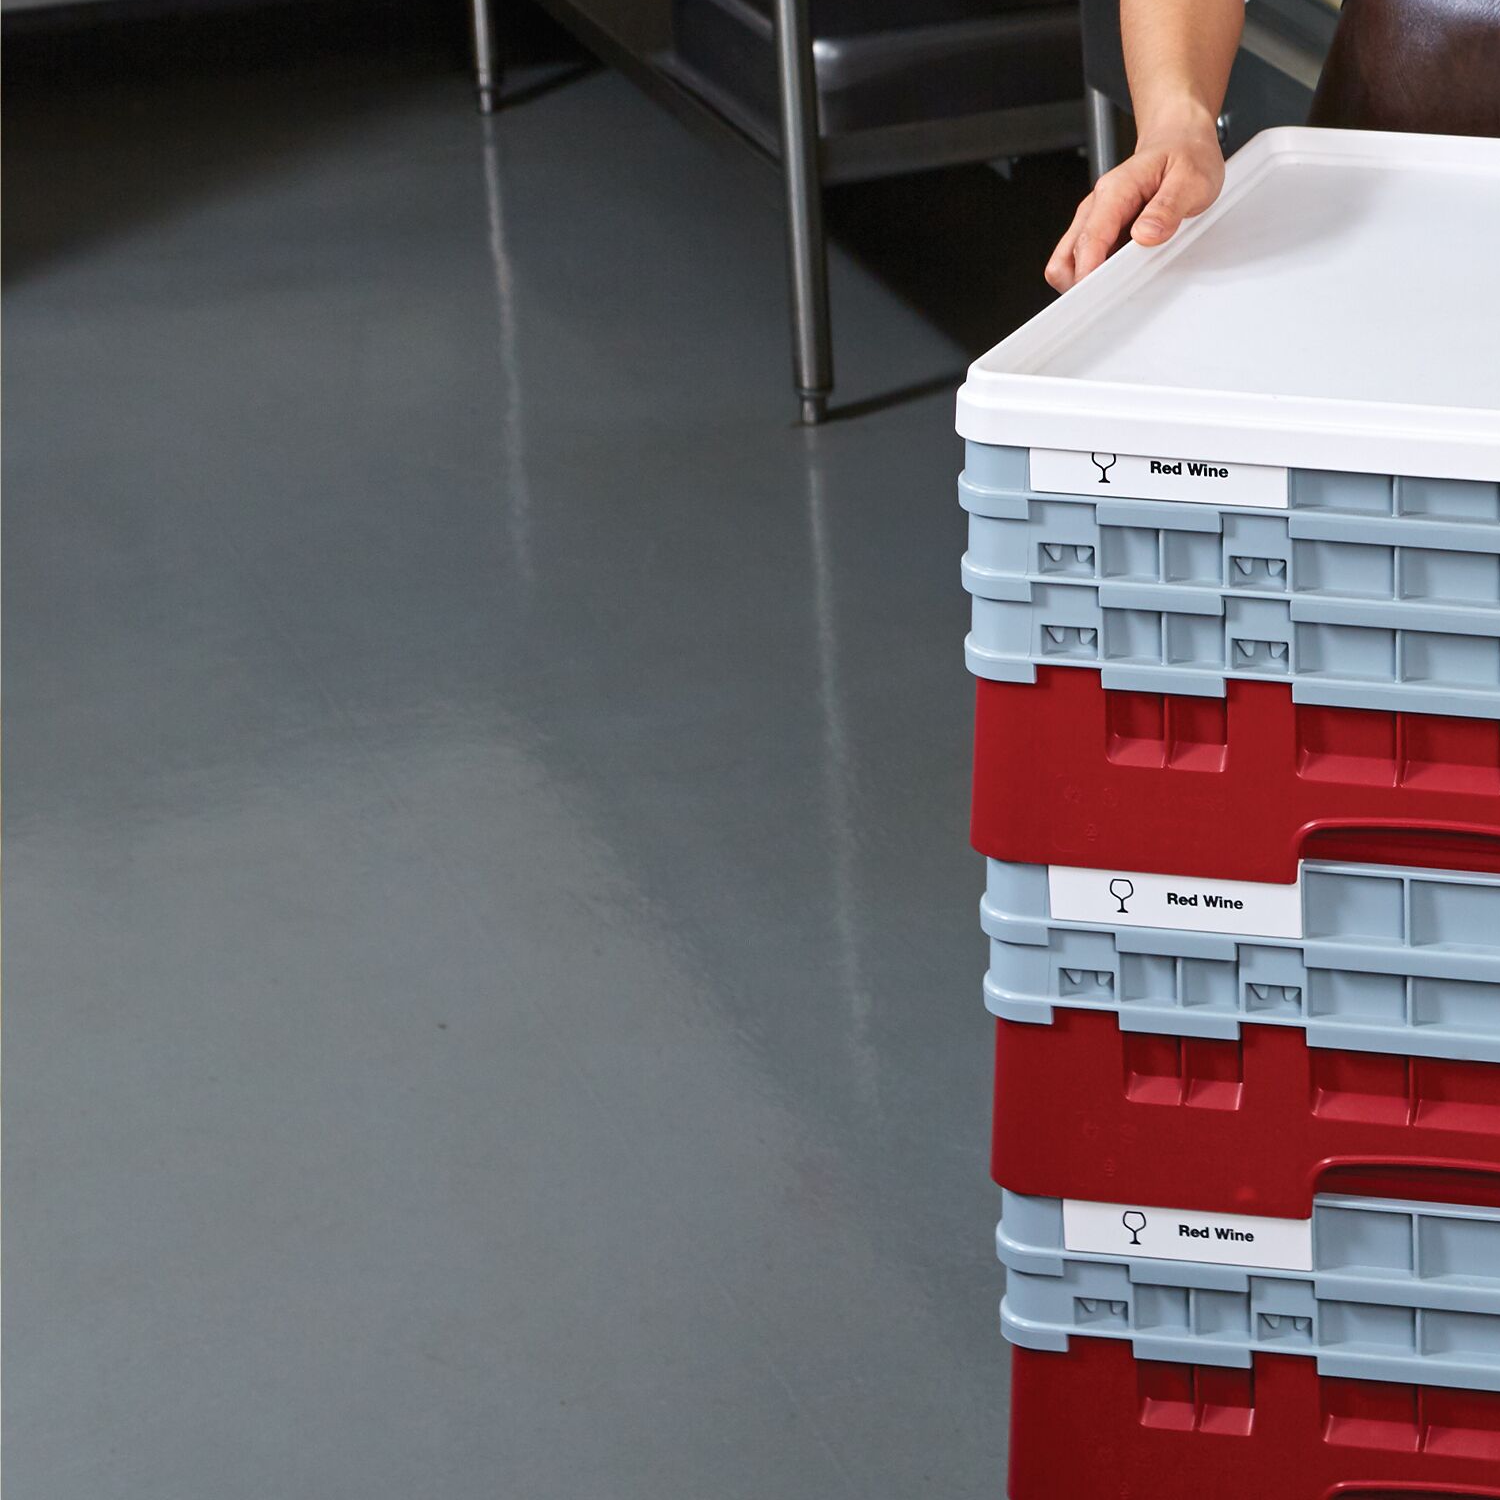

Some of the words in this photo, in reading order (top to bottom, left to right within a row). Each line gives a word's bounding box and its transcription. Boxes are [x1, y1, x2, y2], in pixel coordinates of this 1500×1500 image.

[1150, 460, 1182, 476] Red
[1186, 462, 1229, 479] Wine
[1166, 892, 1199, 907] Red
[1202, 894, 1244, 910] Wine
[1178, 1224, 1210, 1239] Red
[1214, 1227, 1255, 1243] Wine
